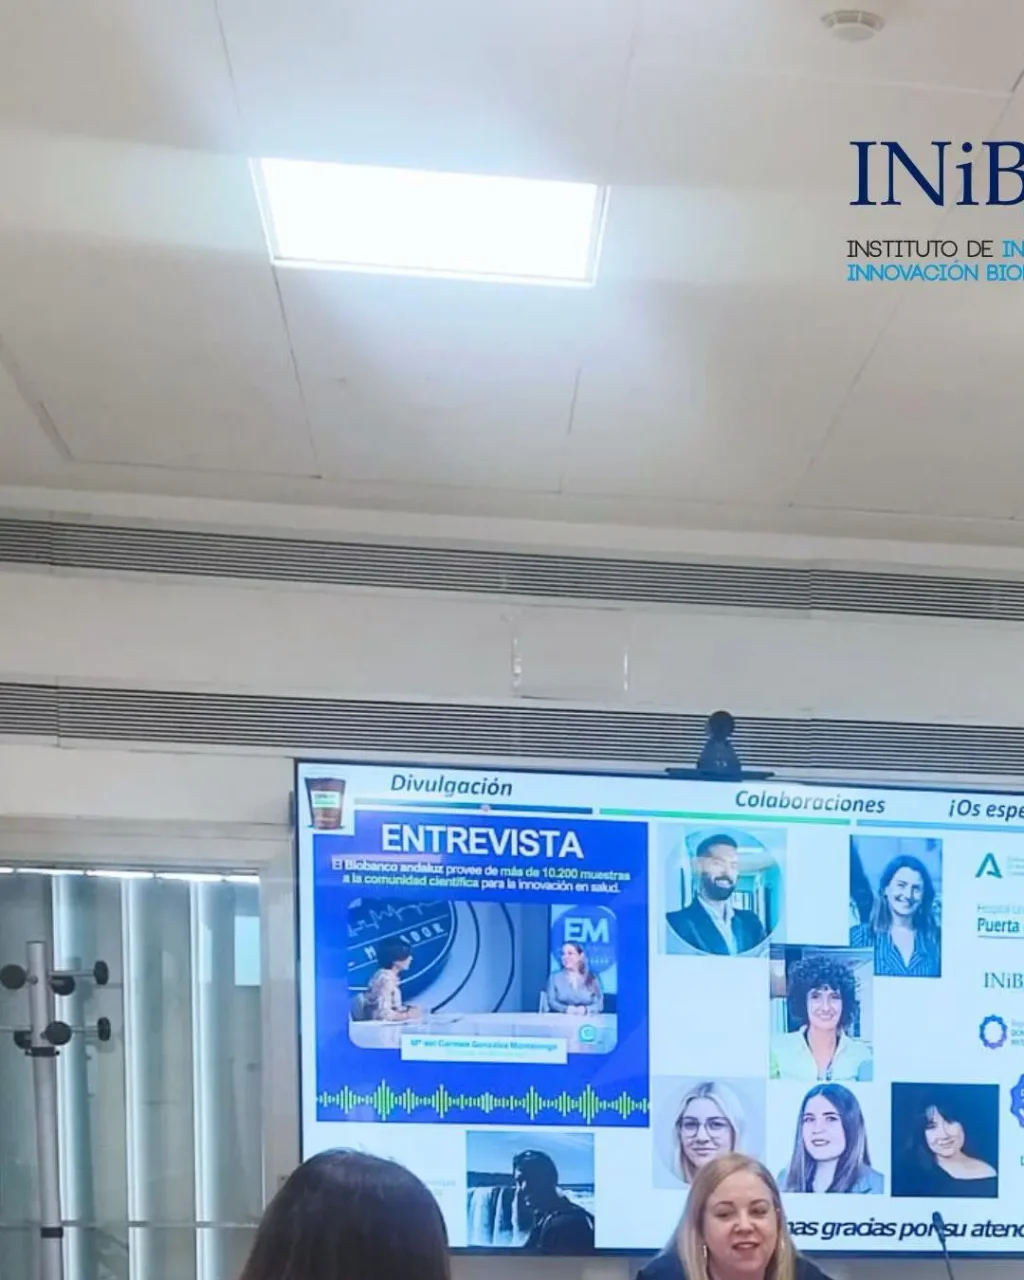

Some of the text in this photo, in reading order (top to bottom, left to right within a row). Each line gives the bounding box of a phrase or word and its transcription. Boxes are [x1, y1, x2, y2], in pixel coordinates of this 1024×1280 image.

[390, 774, 513, 797] Divulgación
[735, 790, 886, 813] Colaboraciones
[948, 799, 981, 818] ¡Os
[381, 824, 585, 858] ENTREVISTA
[345, 860, 399, 872] Biobanco
[400, 862, 444, 874] andaluz
[446, 864, 482, 877] provee
[484, 865, 499, 876] de
[500, 865, 524, 877] más
[525, 866, 540, 877] de
[579, 869, 631, 881] muestras
[352, 872, 362, 884] la
[364, 873, 427, 886] comunidad
[481, 879, 505, 891] para
[507, 878, 517, 889] la
[518, 879, 574, 892] innovación
[575, 883, 589, 892] en
[564, 917, 610, 943] EM
[977, 917, 1019, 933] Puerta
[821, 1217, 897, 1240] gracias
[942, 1223, 967, 1238] su
